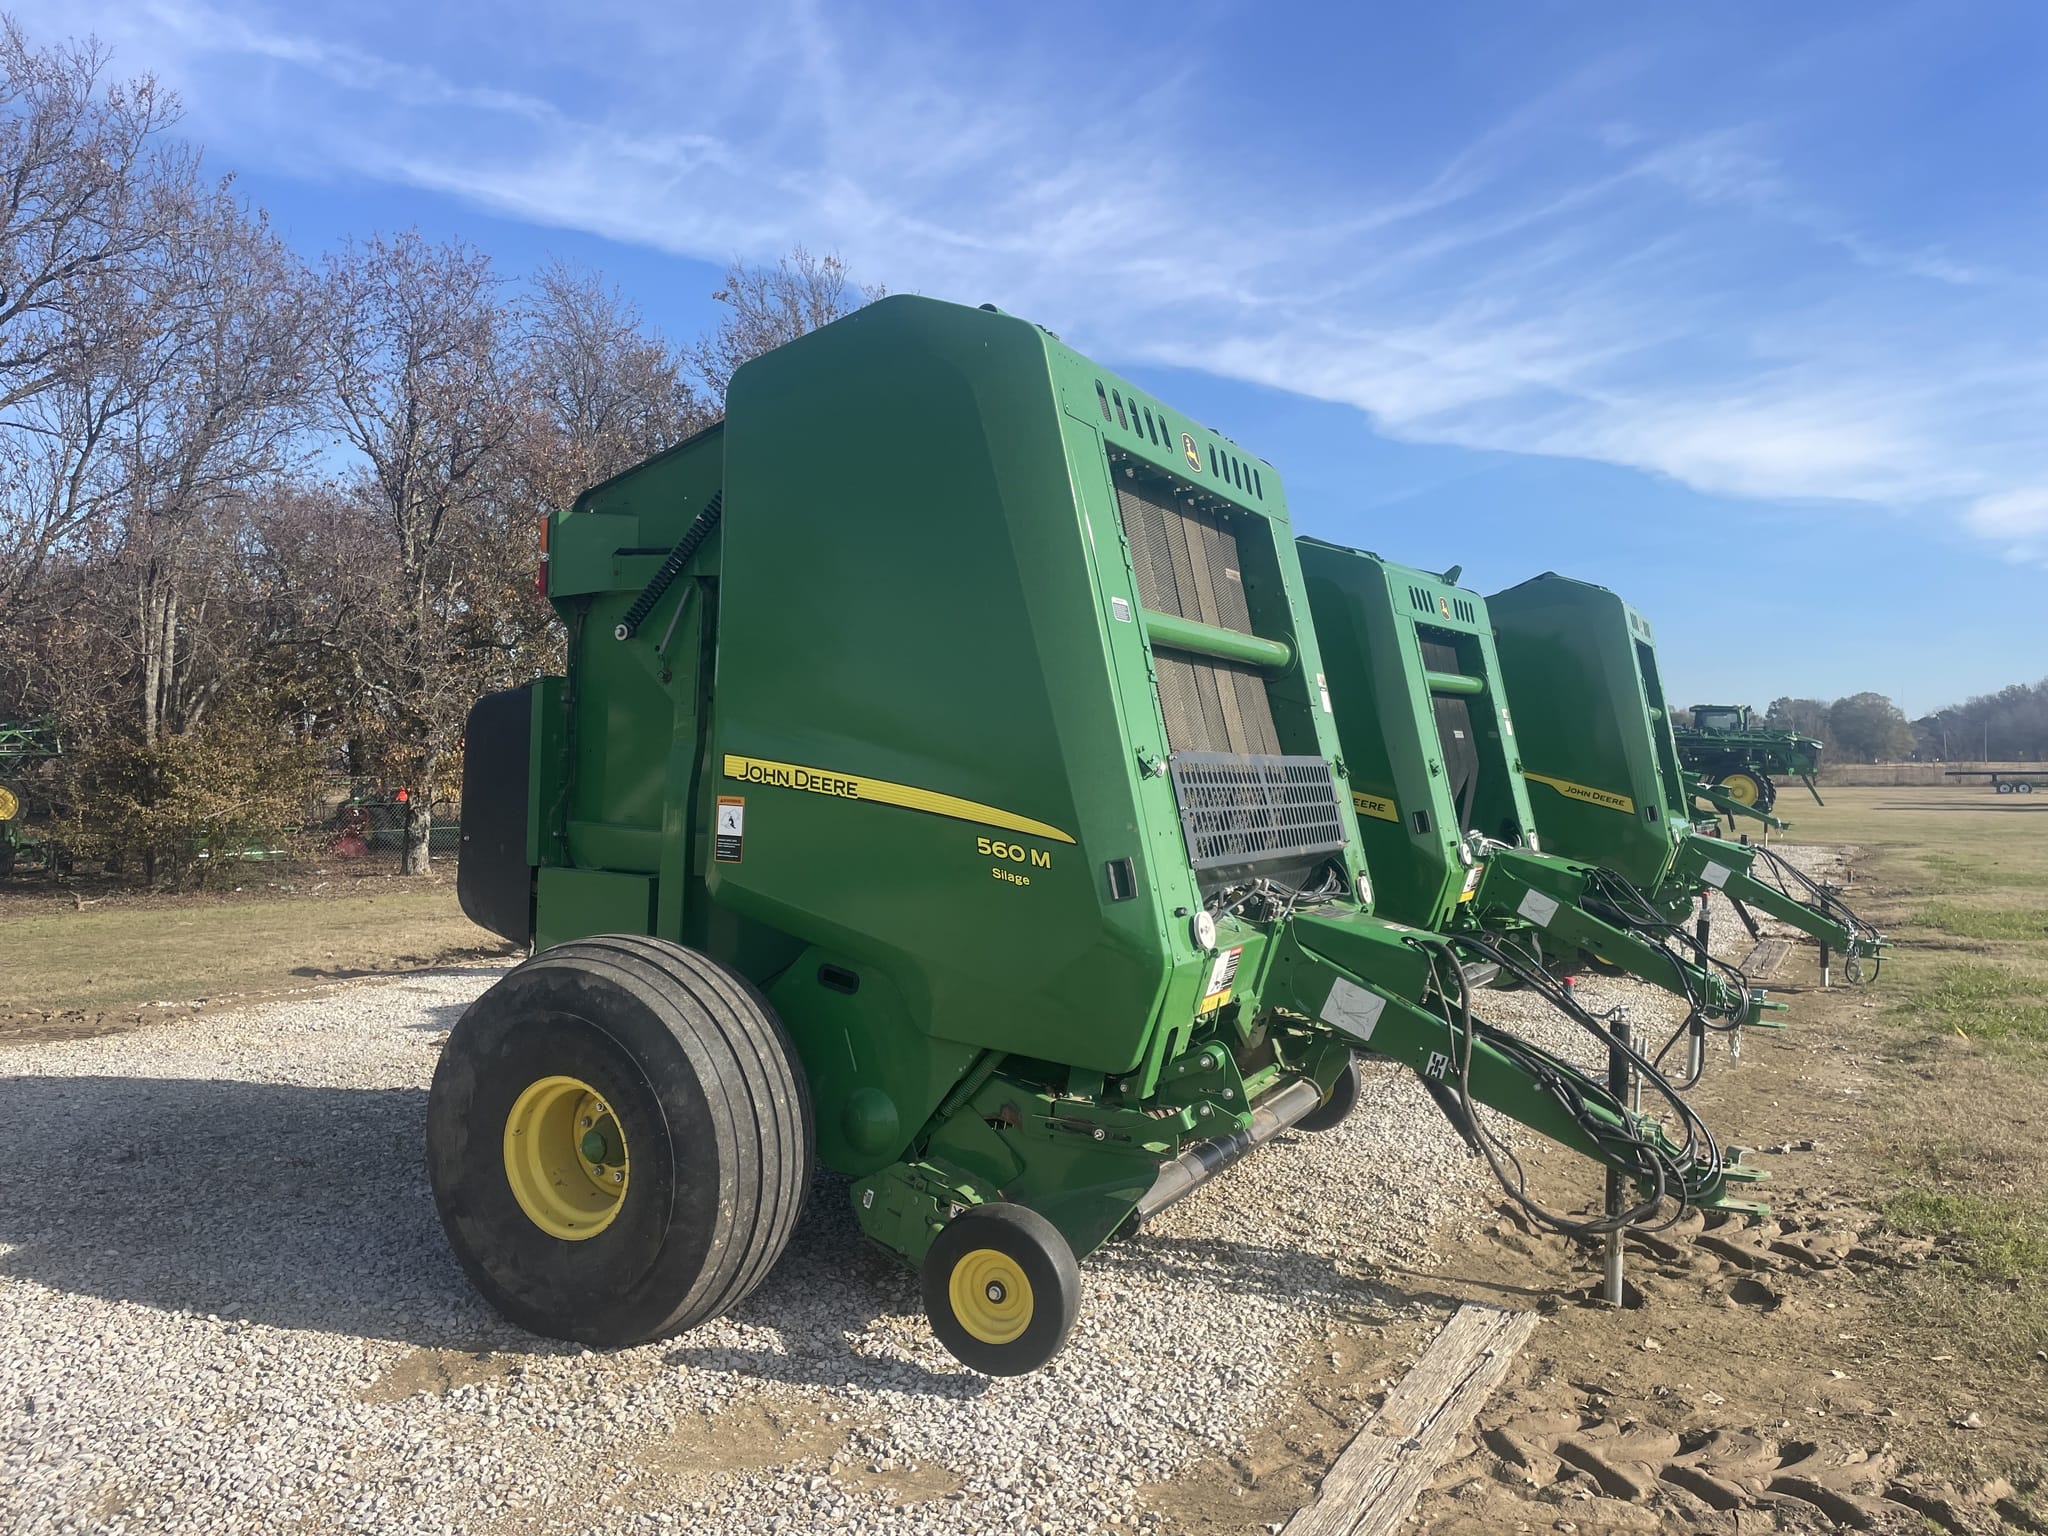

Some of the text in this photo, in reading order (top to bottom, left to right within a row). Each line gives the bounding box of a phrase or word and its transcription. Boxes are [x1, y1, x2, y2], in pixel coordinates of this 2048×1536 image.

[738, 761, 858, 797] JOHN DEERE
[1352, 797, 1386, 812] EERE
[1565, 785, 1625, 807] JOHN DEERE
[976, 836, 1052, 869] 560 M
[992, 867, 1031, 886] Silage
